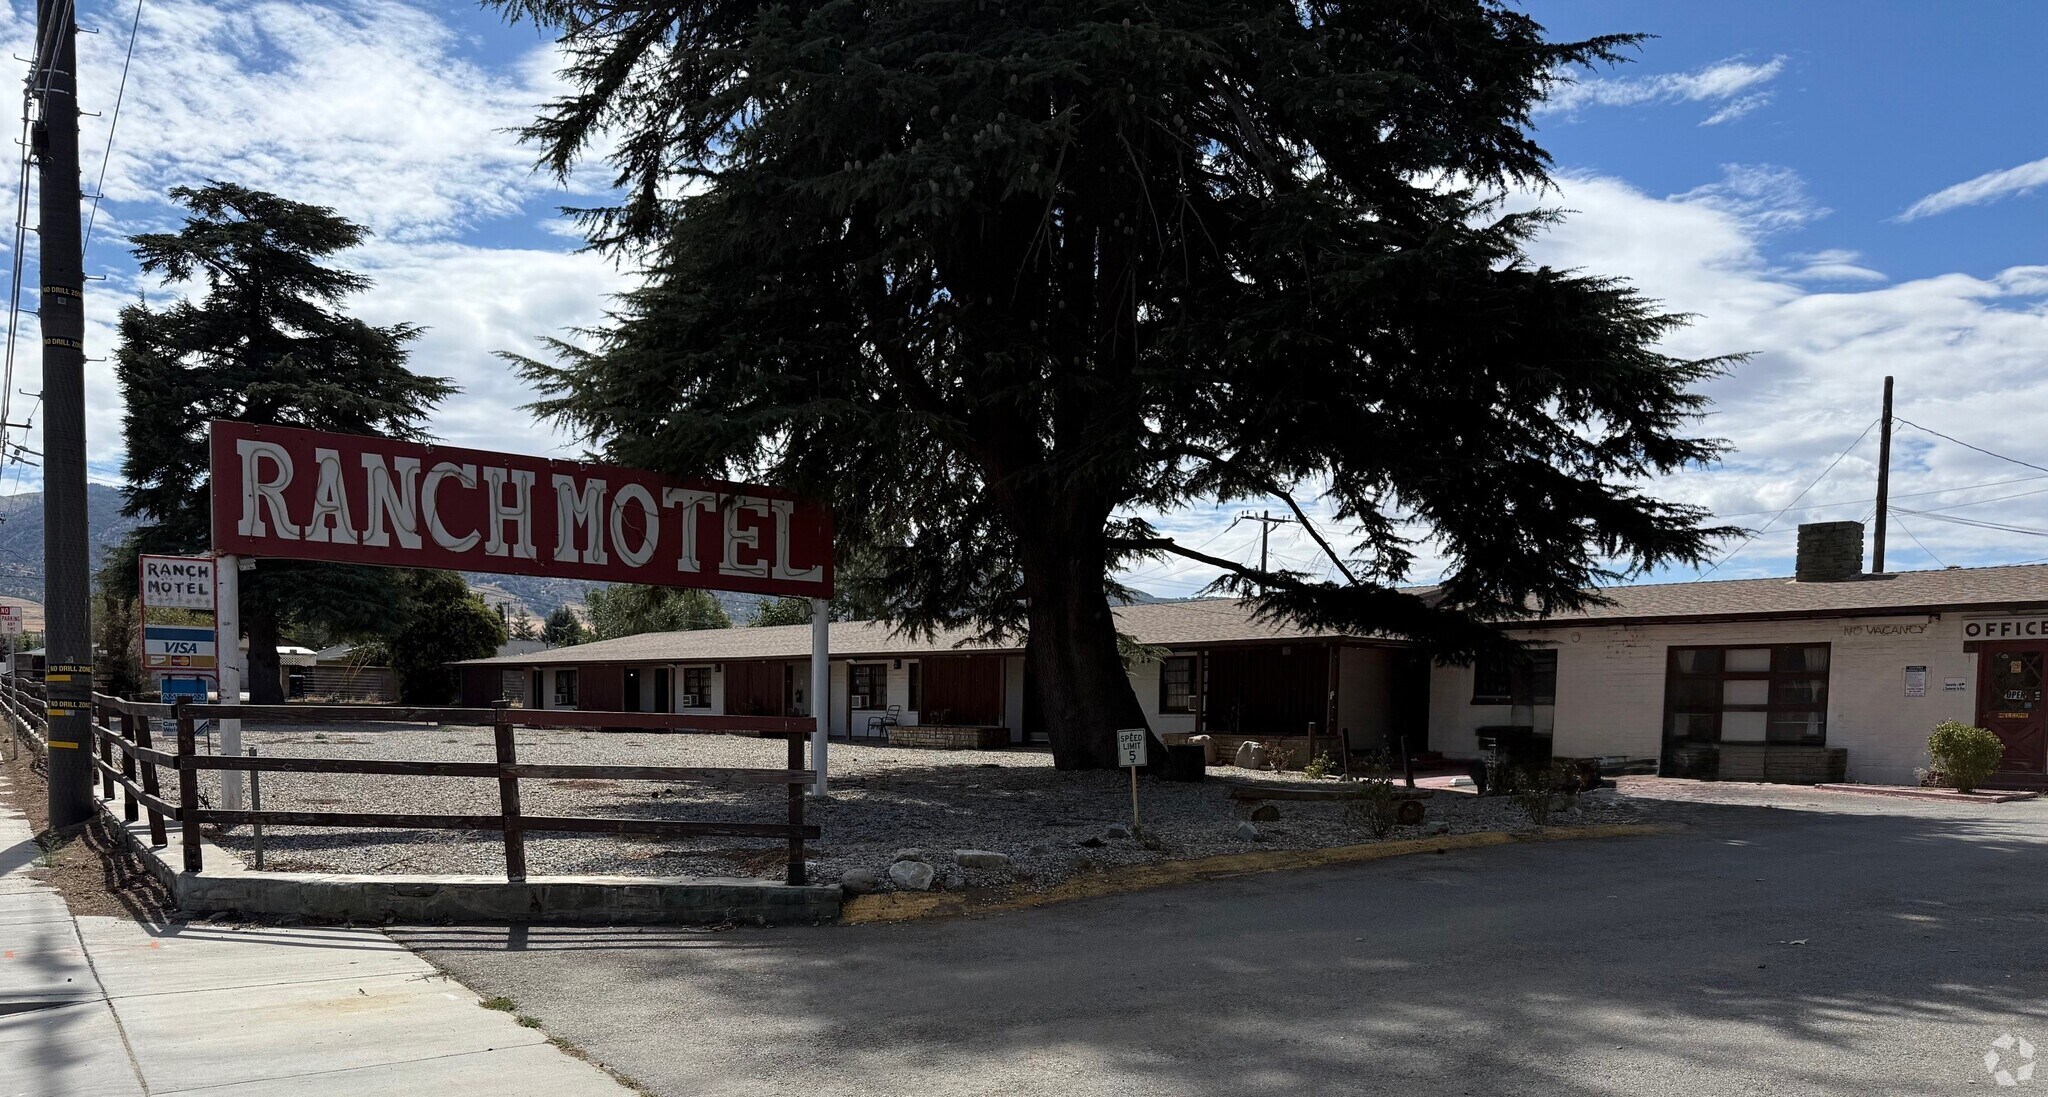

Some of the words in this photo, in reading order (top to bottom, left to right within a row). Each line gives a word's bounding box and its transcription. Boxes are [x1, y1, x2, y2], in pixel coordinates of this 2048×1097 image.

[51, 286, 70, 295] DRILL
[71, 289, 82, 298] ZON
[52, 338, 70, 347] DRILL
[71, 340, 82, 349] ZON
[236, 438, 539, 562] RANCH
[552, 472, 824, 584] MOTEL
[147, 562, 209, 578] RANCH
[148, 581, 209, 596] MOTEL
[1843, 625, 1862, 636] NO
[1866, 624, 1928, 636] VACANCY
[1965, 620, 2048, 637] OFFICE
[164, 641, 198, 654] VISA
[79, 665, 92, 673] ZONE
[162, 692, 206, 701] AMAN
[59, 700, 78, 708] DRILL
[78, 701, 92, 709] ZONE
[1120, 734, 1143, 742] SPEED
[1123, 742, 1141, 750] LIMIT
[1129, 750, 1137, 761] 5
